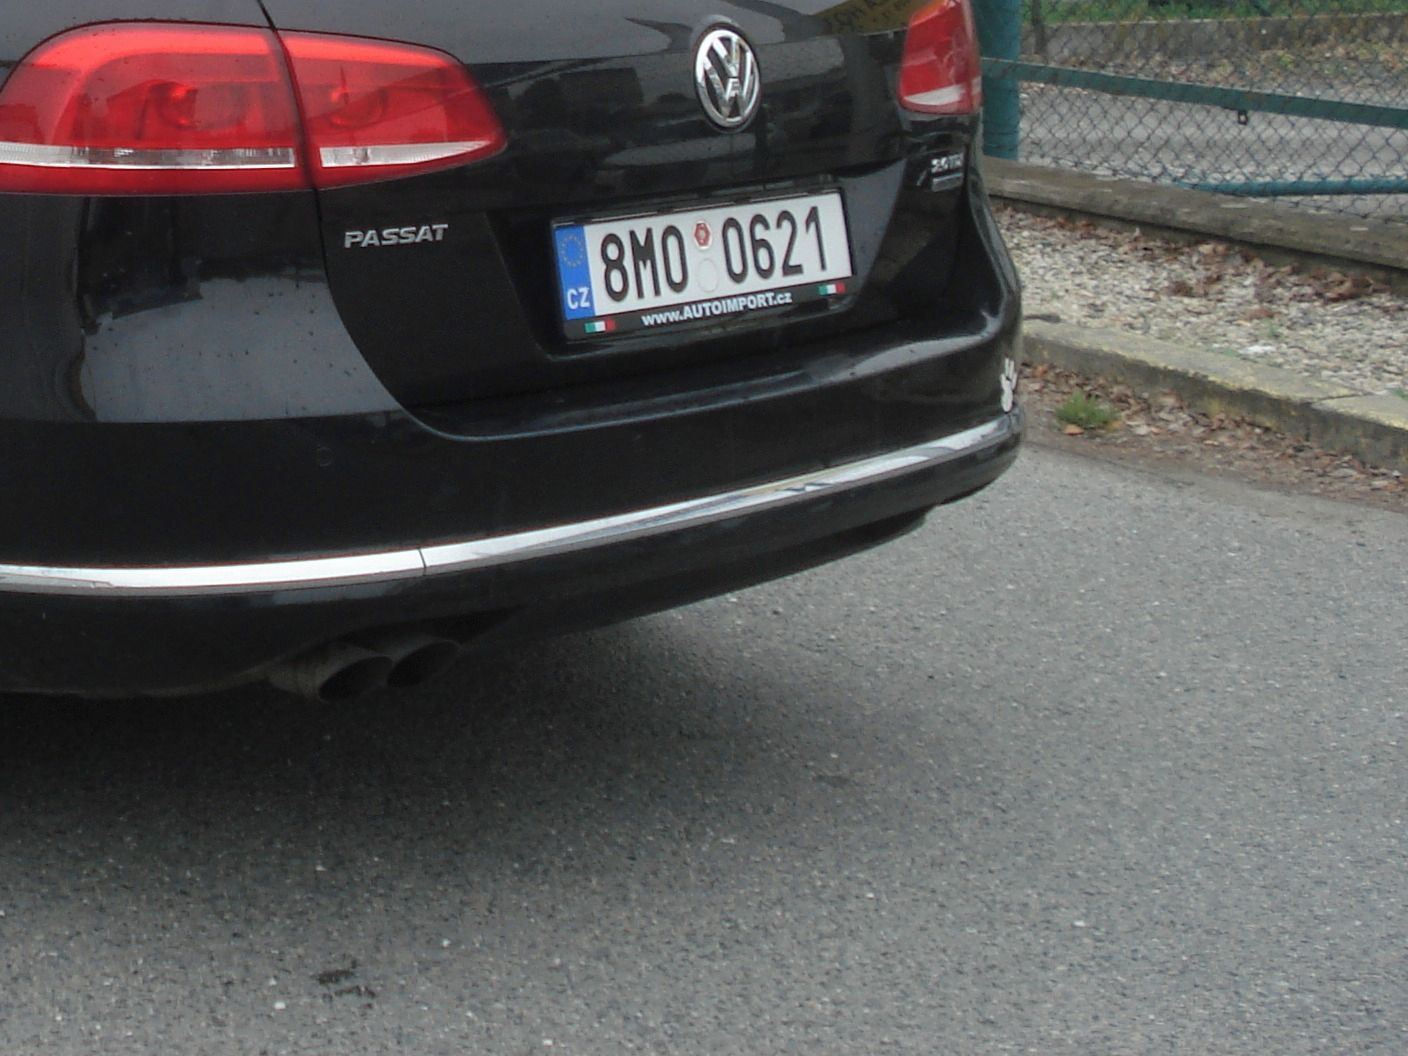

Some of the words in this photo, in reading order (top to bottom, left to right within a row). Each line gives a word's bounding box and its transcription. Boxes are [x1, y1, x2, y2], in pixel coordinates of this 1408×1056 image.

[344, 223, 449, 249] PASSAT
[721, 205, 828, 285] 0621
[566, 287, 590, 310] CZ
[641, 292, 793, 327] www.AUTOIMPORT.cz
